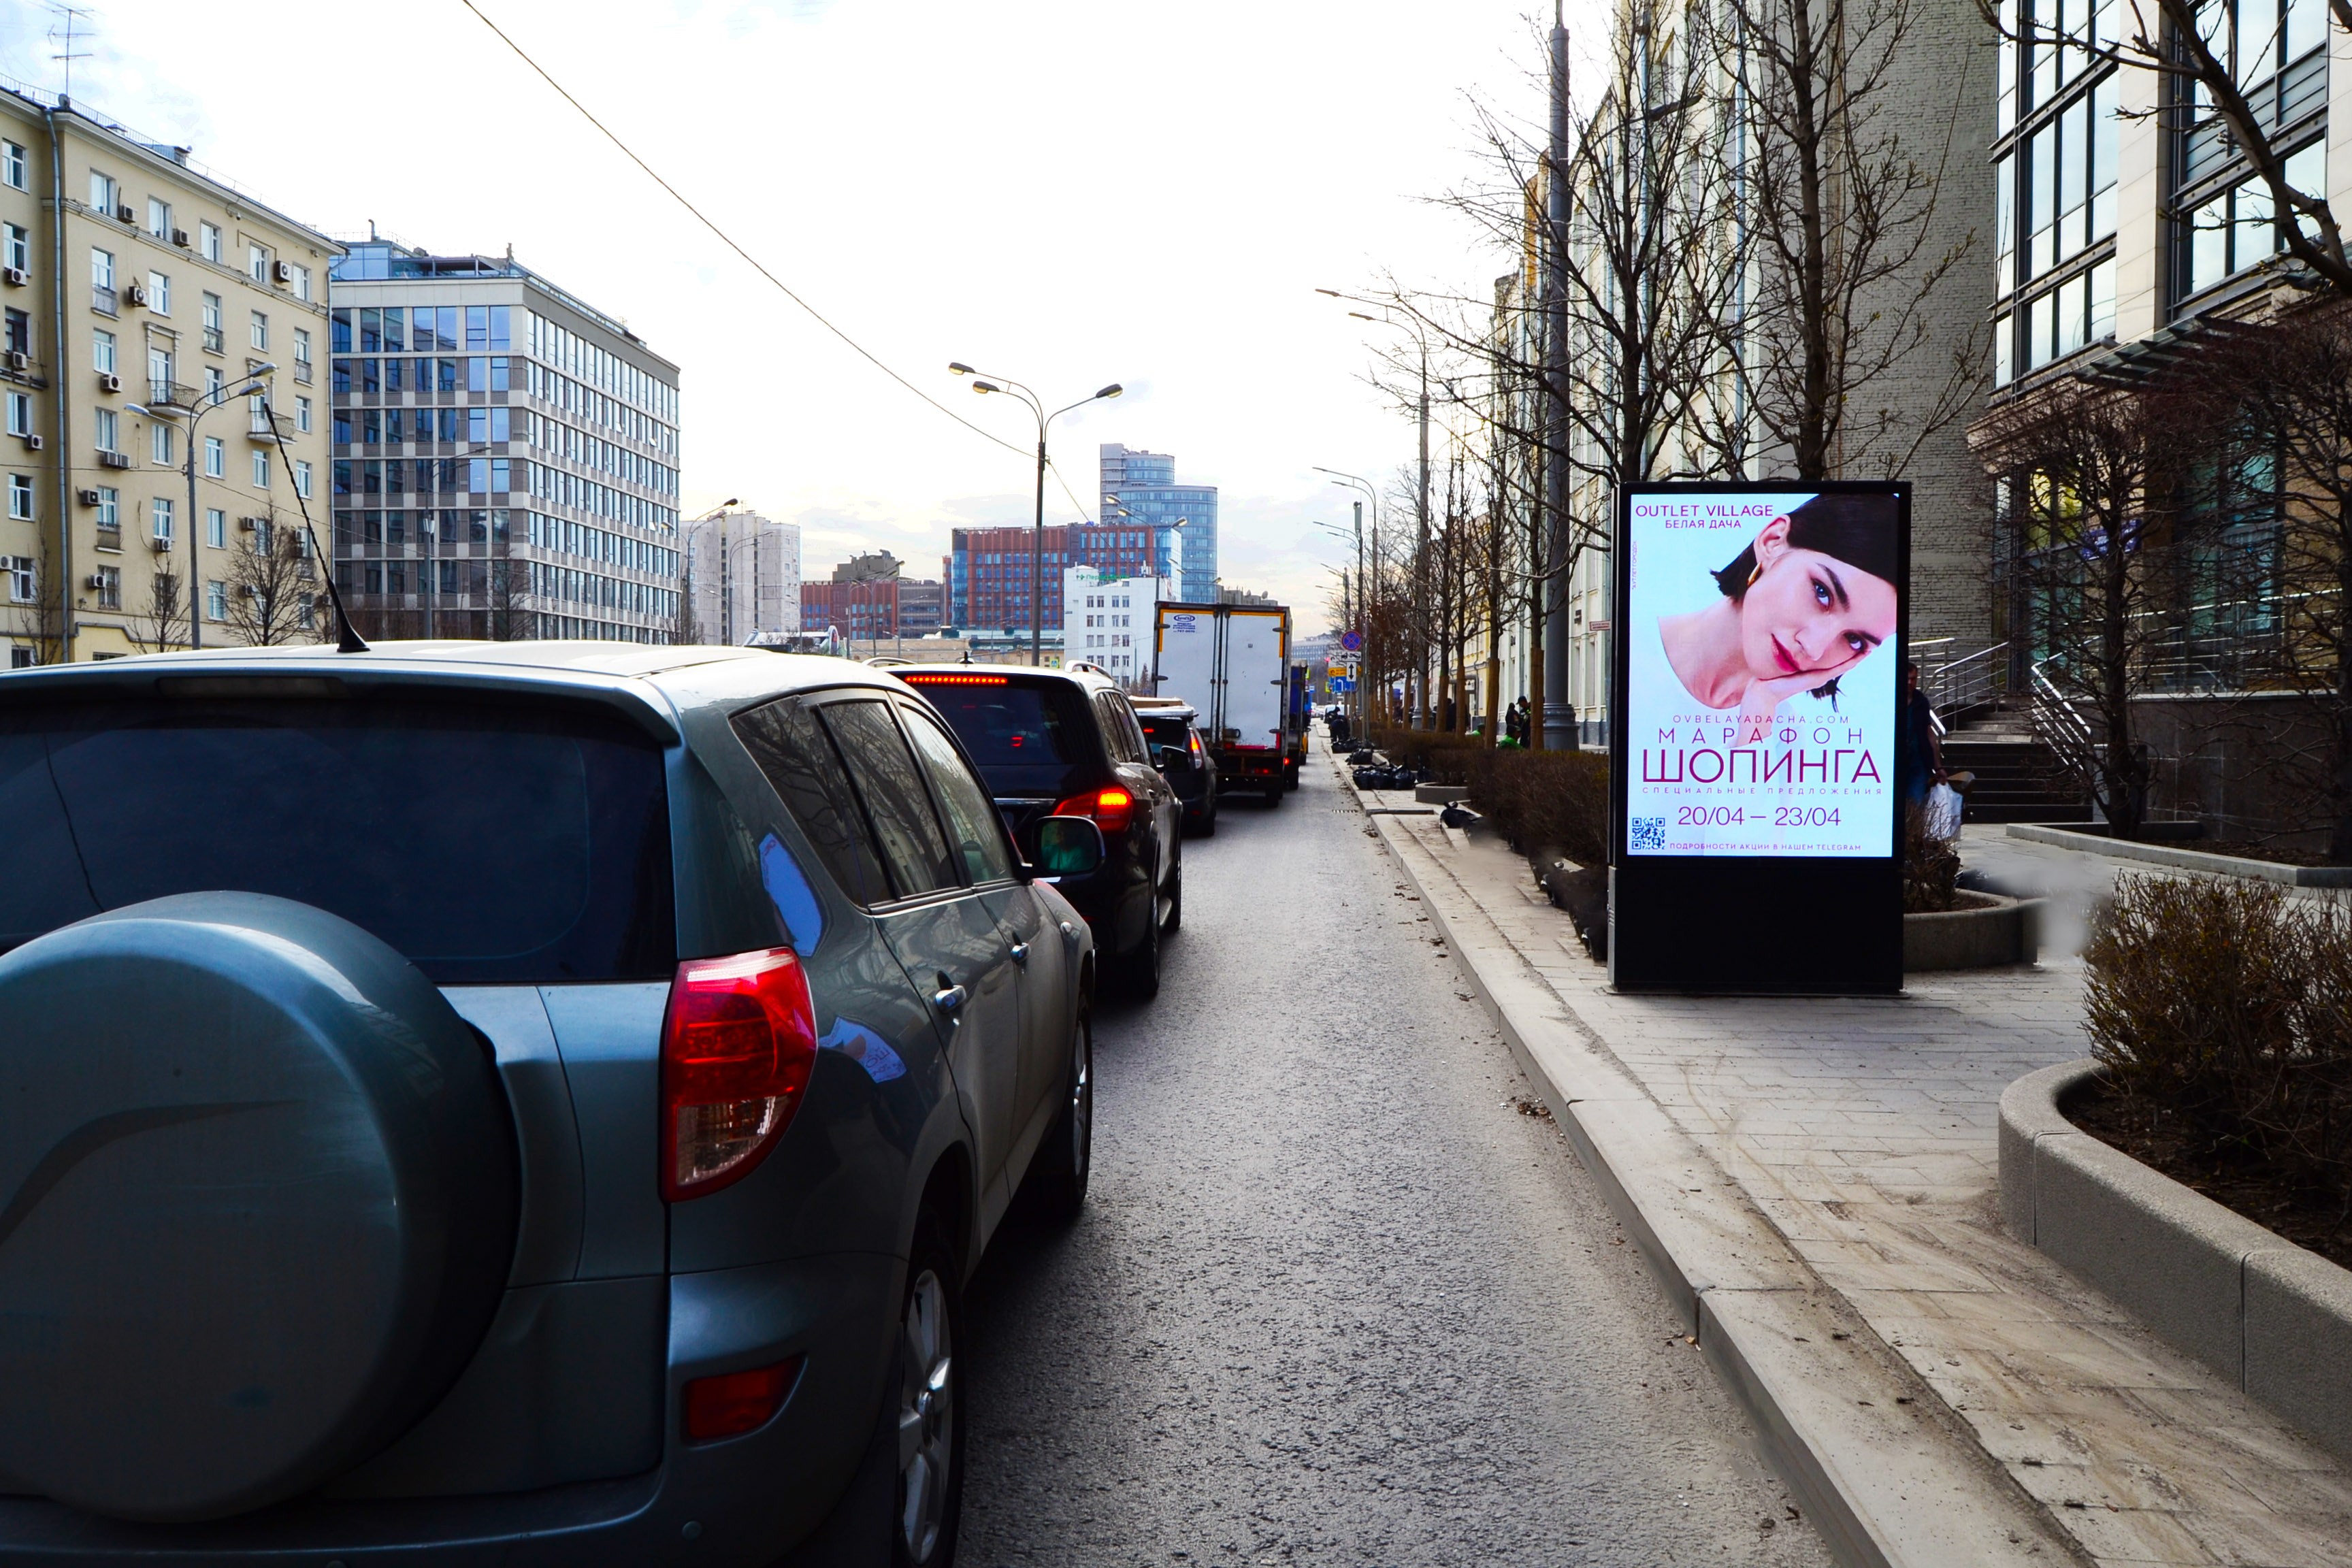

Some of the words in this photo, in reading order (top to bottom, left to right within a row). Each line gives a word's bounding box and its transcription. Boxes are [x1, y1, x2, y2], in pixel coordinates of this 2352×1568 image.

[1635, 505, 1700, 517] OUTLET
[1705, 505, 1774, 517] VILLAGE
[1665, 519, 1705, 529] БЕЛАЯ
[1709, 519, 1742, 529] ДАЧА
[1673, 715, 1849, 723] OVBELAYADACHA.COM
[1659, 727, 1862, 745] МАРАФОН
[1643, 749, 1882, 783] ШОПИНГА
[1642, 787, 1756, 795] СПЕЦИАЛЬНЫЕ
[1767, 787, 1882, 796] ПРЕДЛОЖЕНИЯ
[1678, 806, 1746, 826] 20/04
[1775, 806, 1842, 826] 23/04
